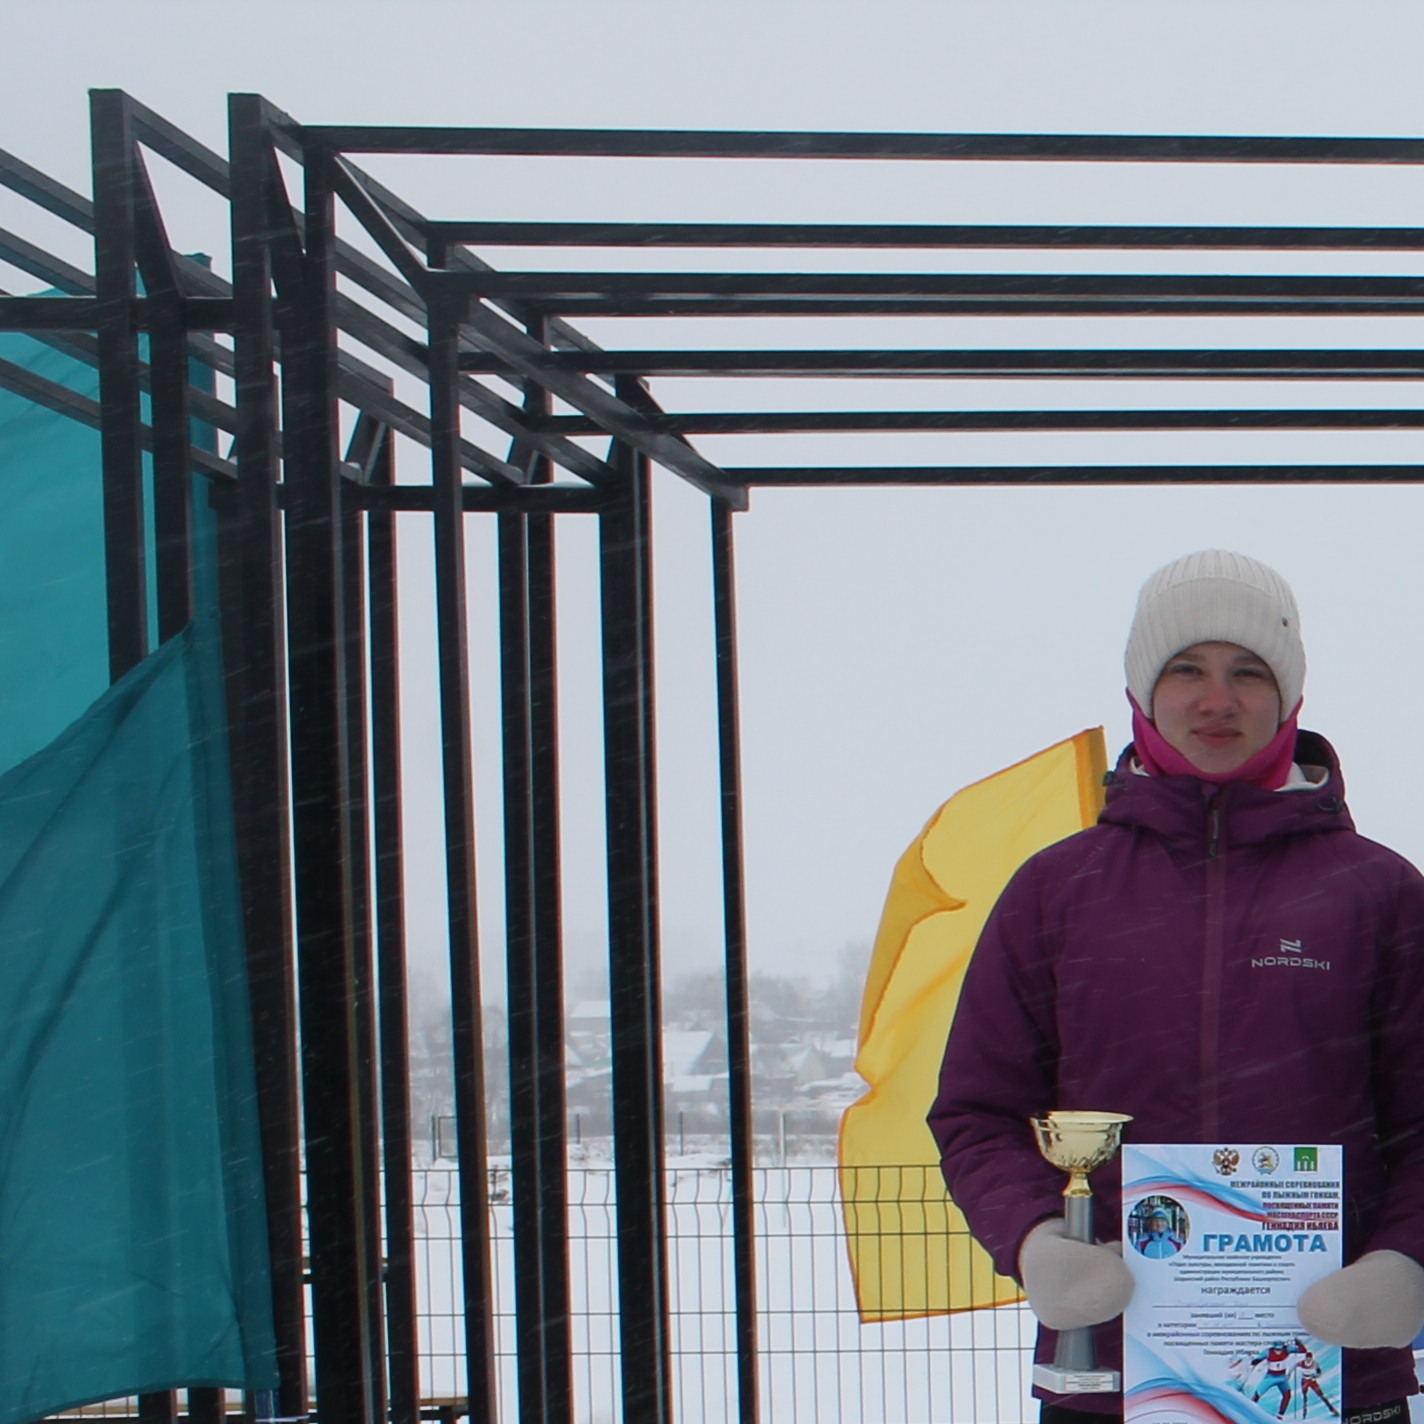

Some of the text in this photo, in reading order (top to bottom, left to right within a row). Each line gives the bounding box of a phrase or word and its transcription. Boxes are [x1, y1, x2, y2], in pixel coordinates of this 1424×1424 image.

[1251, 956, 1331, 970] NORDSKI
[1204, 1235, 1326, 1252] ГРАМОТА
[1201, 1287, 1271, 1295] награждается
